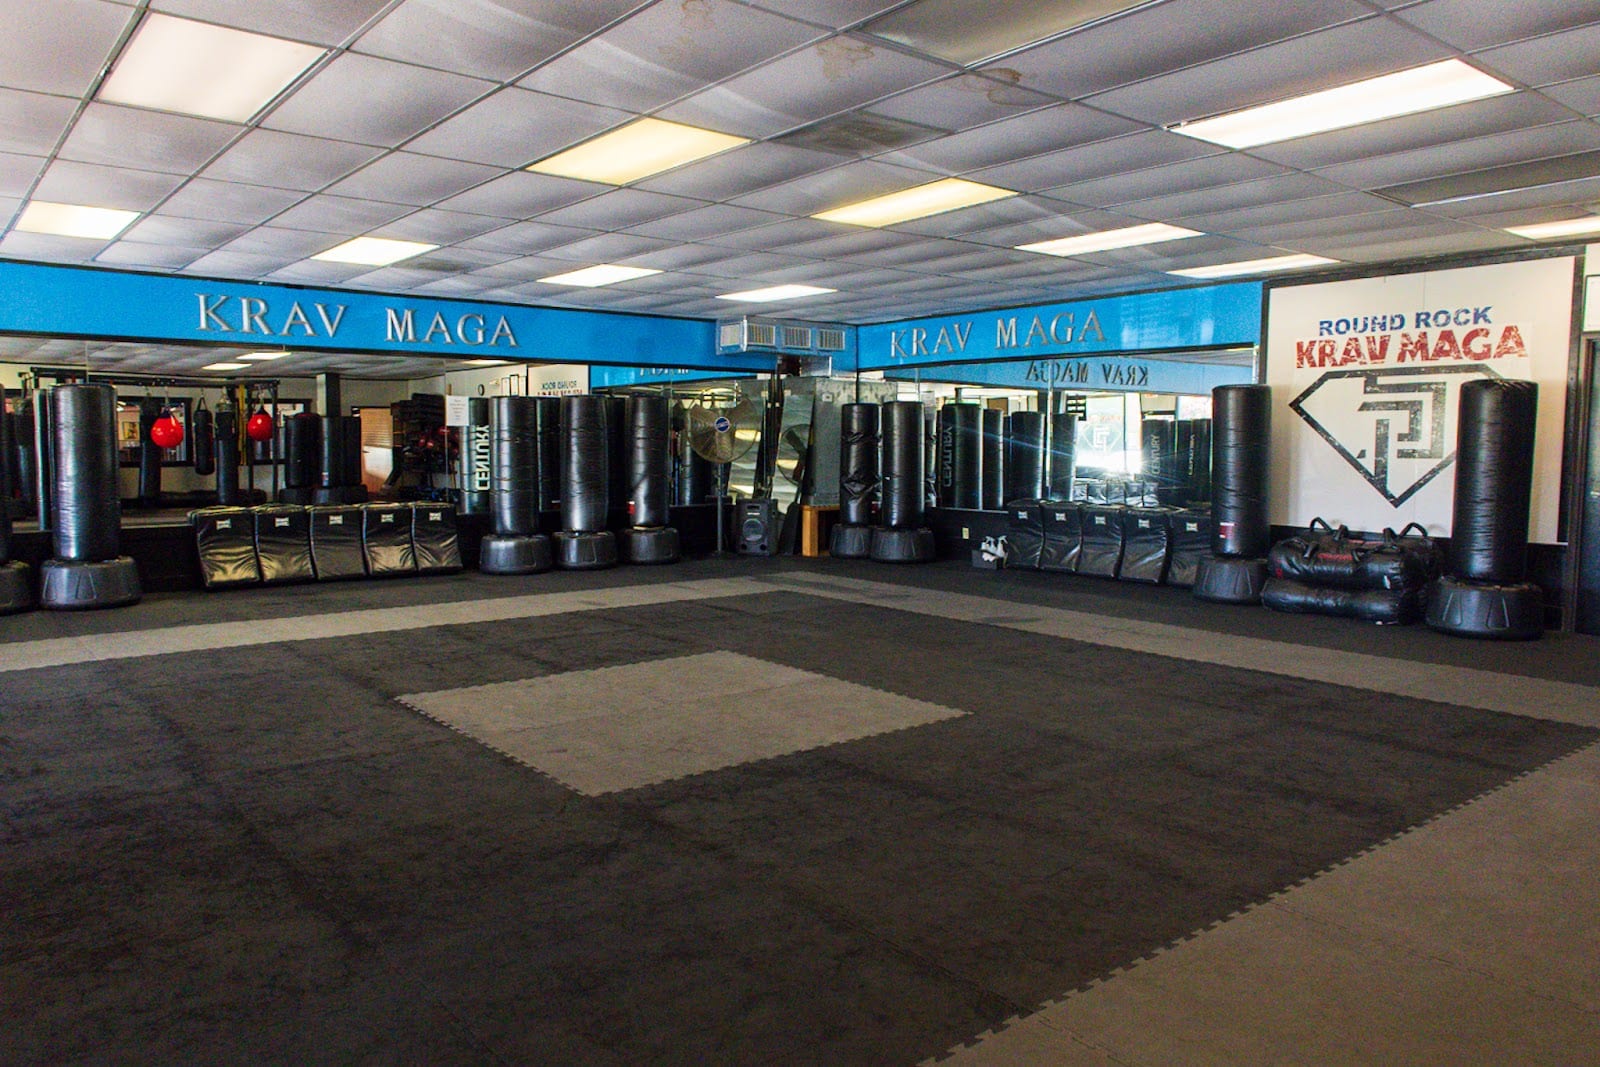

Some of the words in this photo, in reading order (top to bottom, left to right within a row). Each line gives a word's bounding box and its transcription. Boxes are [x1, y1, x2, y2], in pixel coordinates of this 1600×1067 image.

[194, 292, 349, 338] KRAV
[384, 306, 519, 349] MAGA
[890, 321, 973, 358] KRAV
[994, 308, 1105, 349] MAGA
[1318, 313, 1406, 337] ROUND
[1414, 306, 1493, 329] ROCK
[1295, 334, 1392, 369] KRAV
[1396, 325, 1529, 364] MAGA
